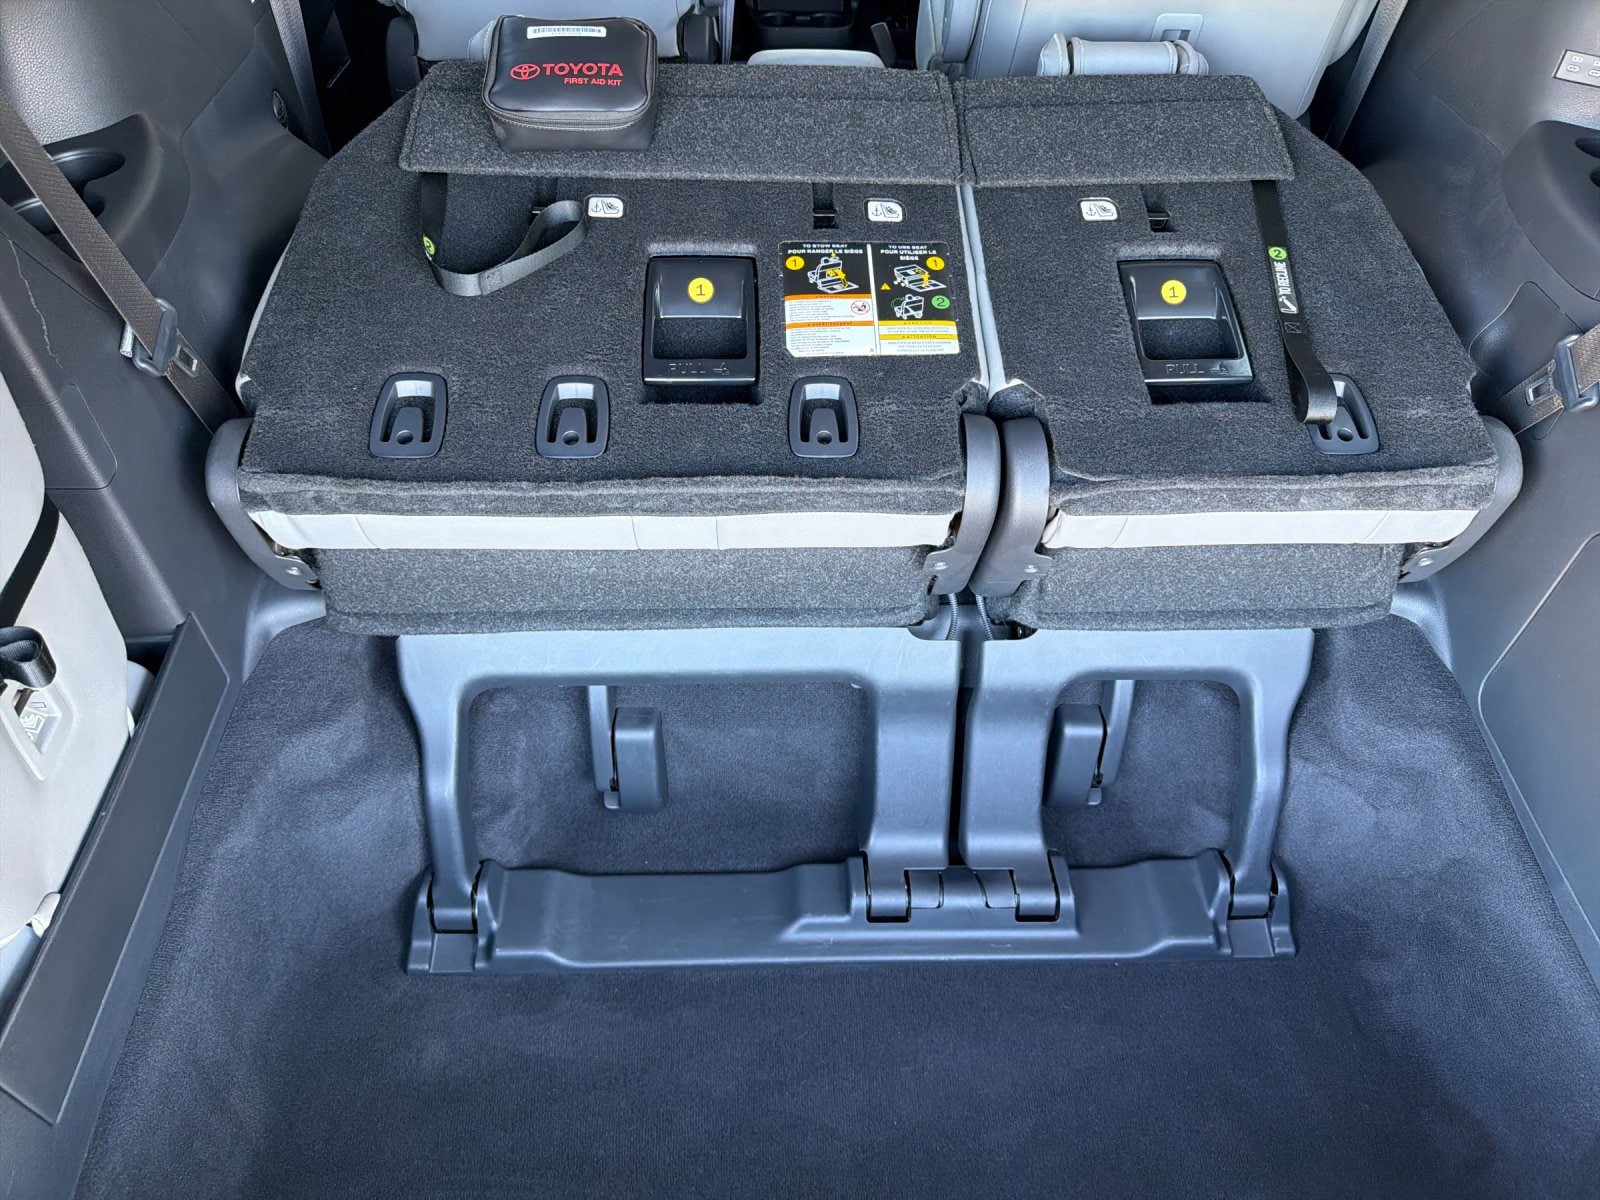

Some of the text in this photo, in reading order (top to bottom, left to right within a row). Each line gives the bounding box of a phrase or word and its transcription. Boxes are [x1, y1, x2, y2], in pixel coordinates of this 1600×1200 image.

[542, 63, 623, 76] TOYOTA
[564, 77, 622, 86] FIRST AID KIT
[1273, 261, 1292, 296] TO RECLINE
[1165, 362, 1205, 374] PULL
